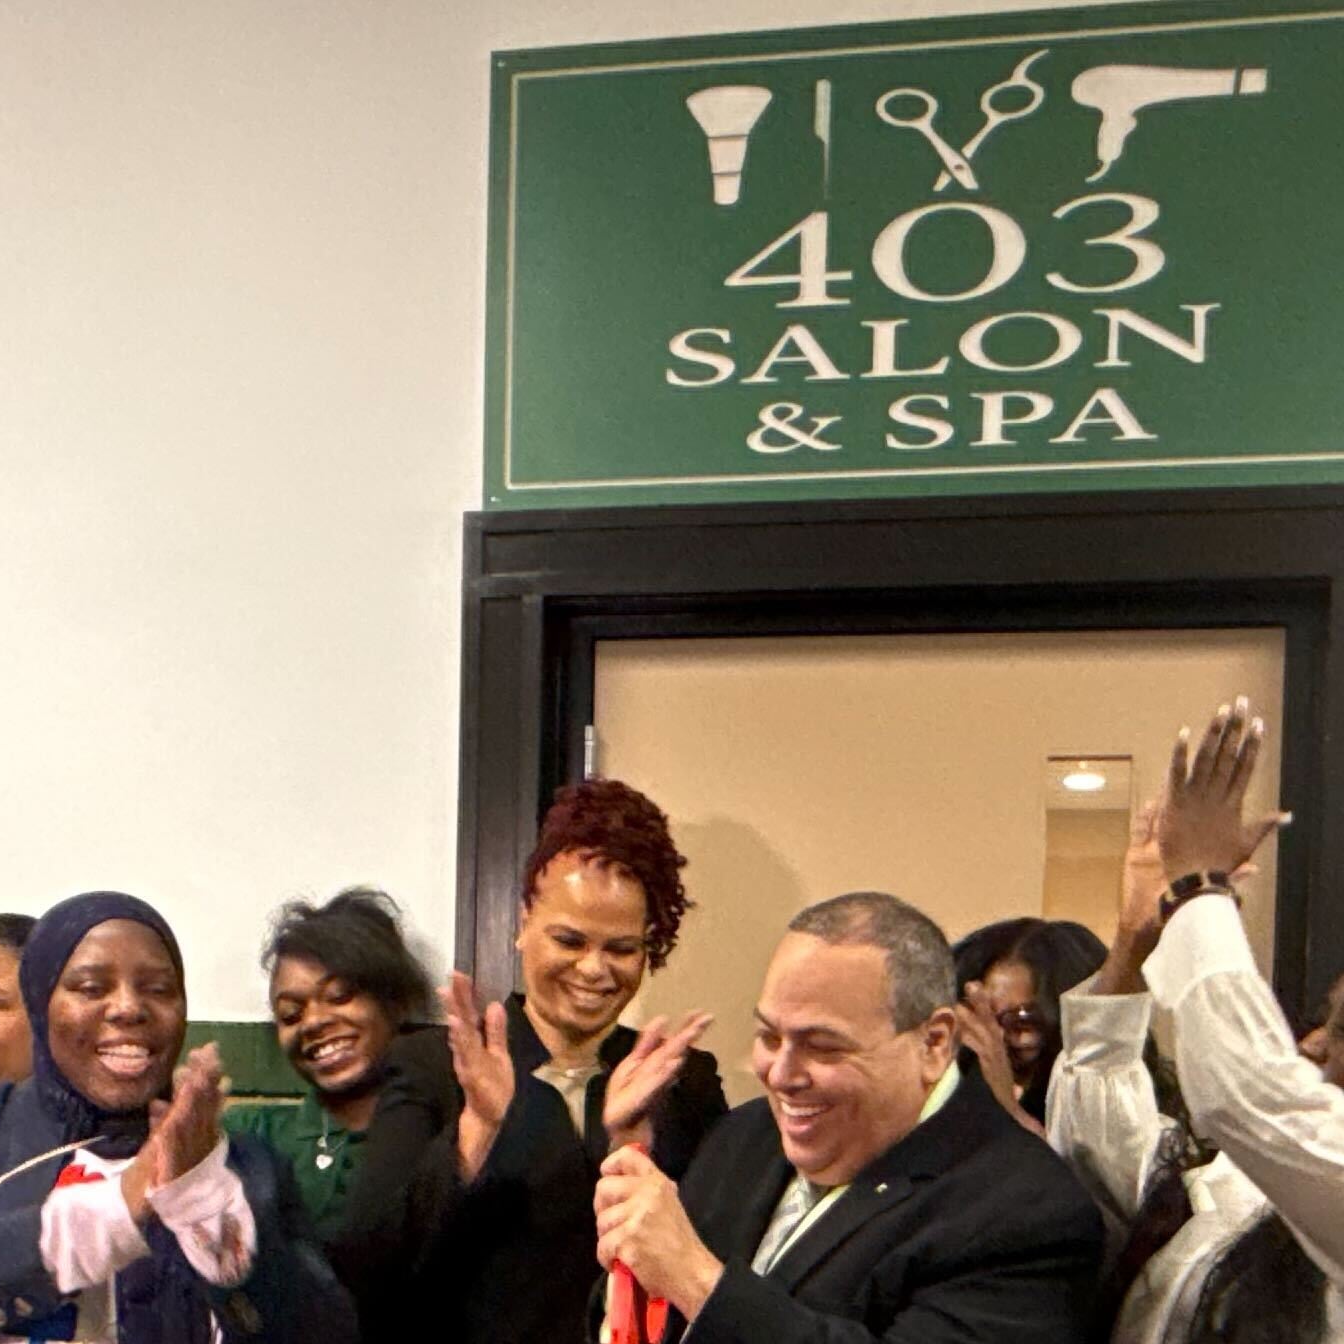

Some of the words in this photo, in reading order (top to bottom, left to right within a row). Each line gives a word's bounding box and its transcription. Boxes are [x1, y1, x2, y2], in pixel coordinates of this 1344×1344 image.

[723, 192, 1166, 309] 403
[666, 303, 1221, 388] SALON
[745, 402, 844, 454] &
[885, 388, 1158, 450] SPA
